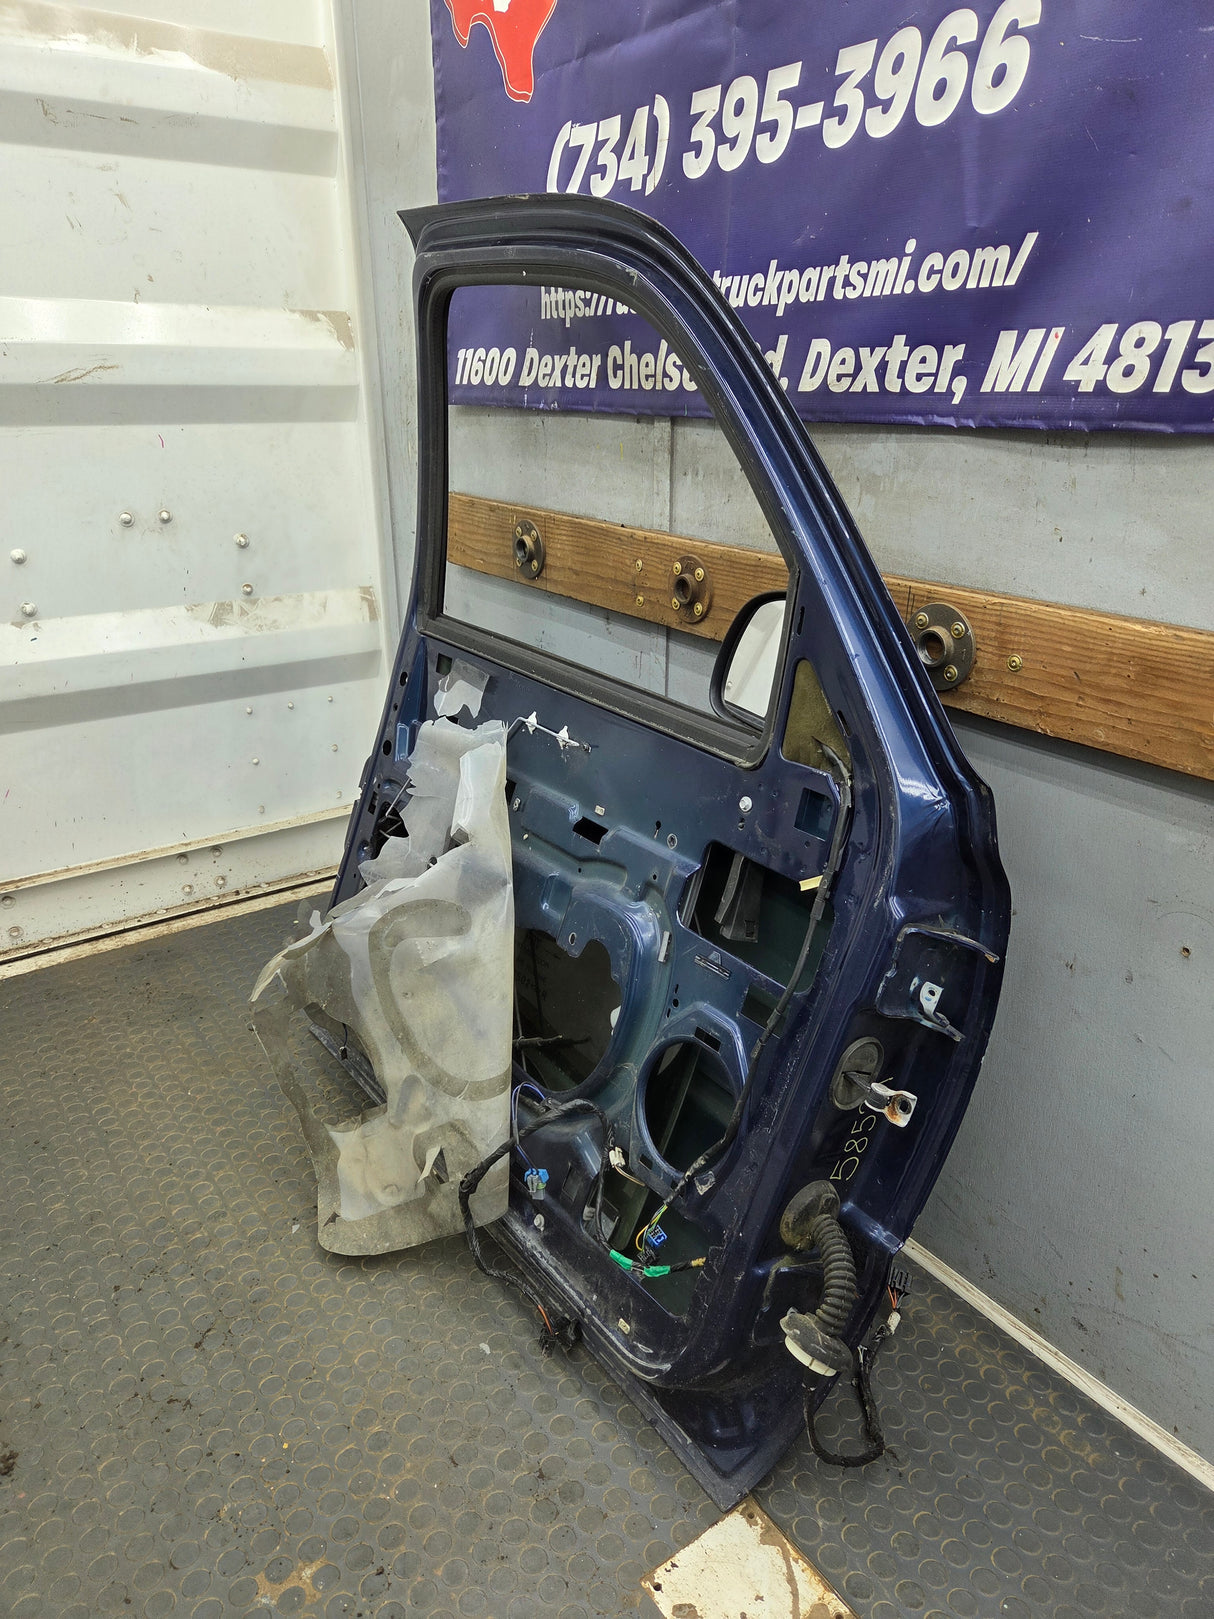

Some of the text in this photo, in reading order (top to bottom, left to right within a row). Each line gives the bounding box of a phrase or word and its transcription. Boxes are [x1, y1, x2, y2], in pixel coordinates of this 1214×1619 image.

[547, 0, 1042, 197] (734) 395-3966
[455, 347, 517, 386] 11600
[519, 346, 601, 388] Dexter
[607, 340, 698, 392] Chels
[753, 334, 788, 391] d.
[798, 333, 967, 405] Dexter,
[980, 326, 1066, 393] MI
